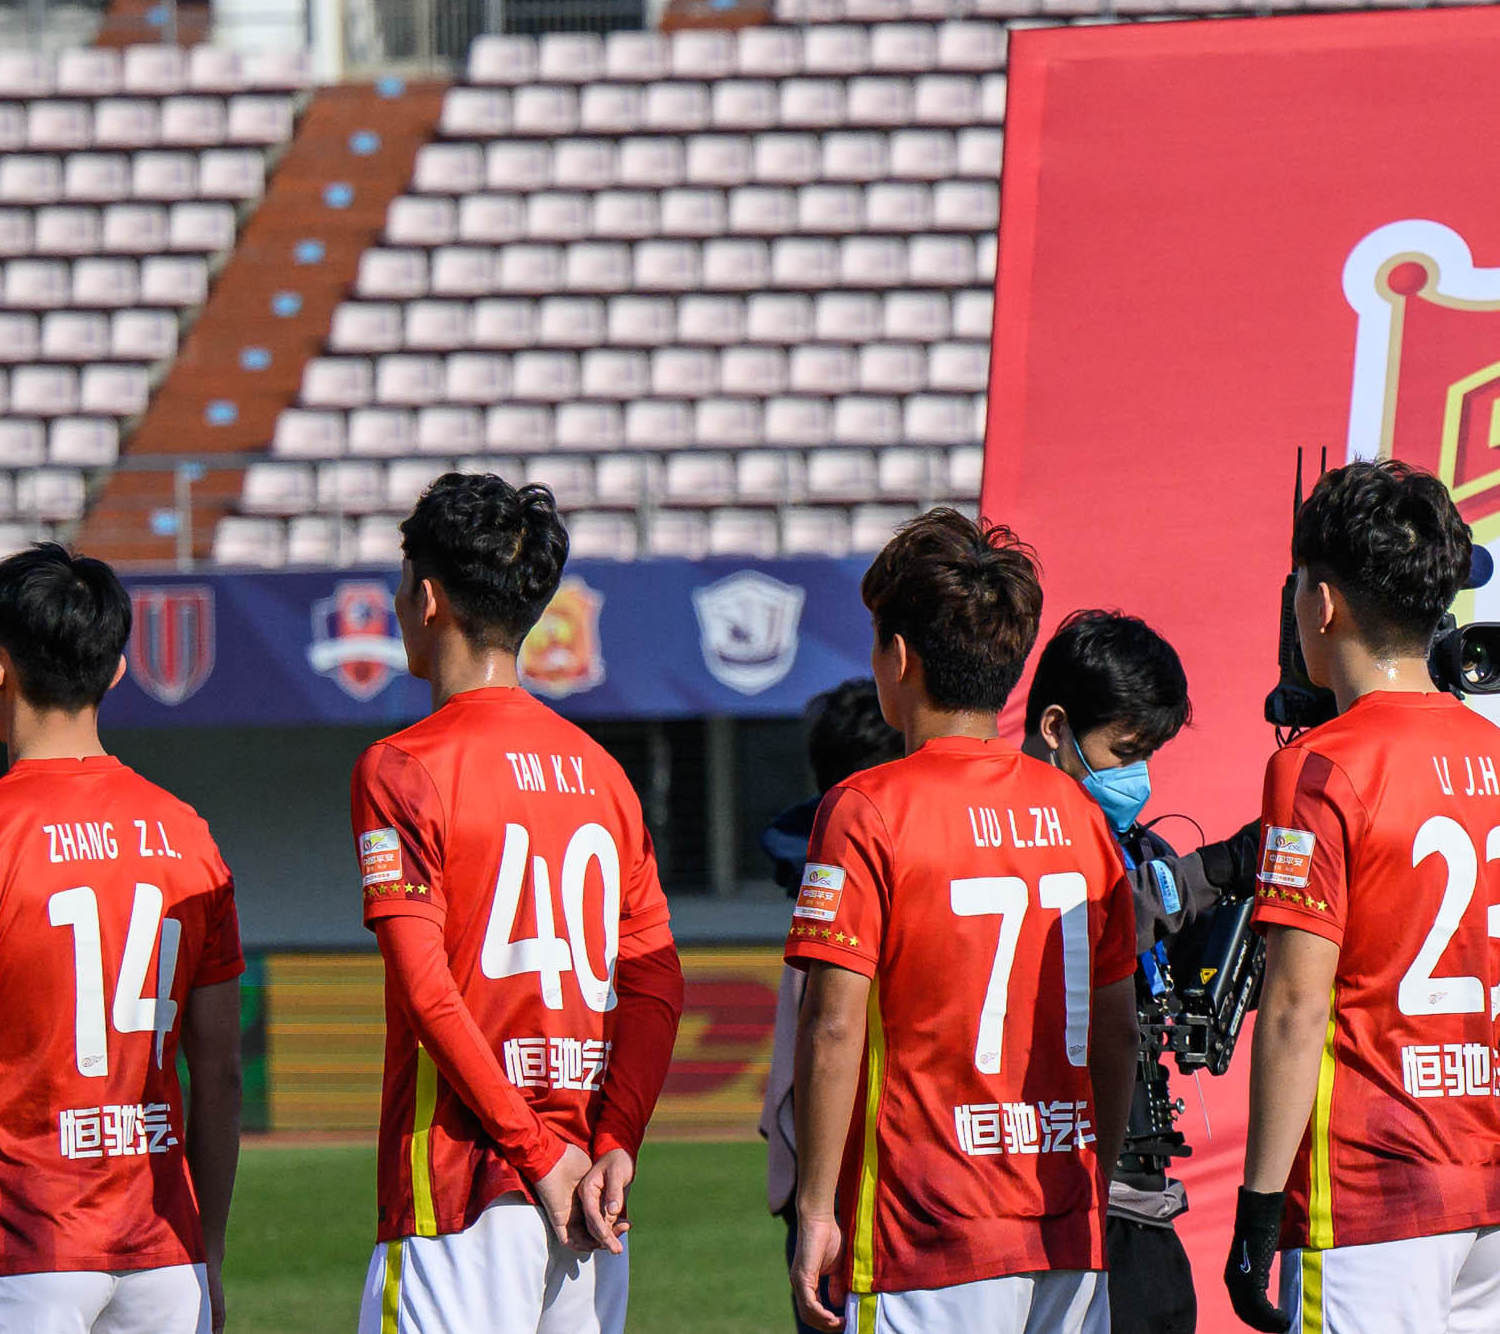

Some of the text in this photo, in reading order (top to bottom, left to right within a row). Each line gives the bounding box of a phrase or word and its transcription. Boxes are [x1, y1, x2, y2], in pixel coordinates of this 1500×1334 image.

[505, 752, 596, 795] TAN K.Y.
[1431, 755, 1454, 796] LI
[42, 820, 182, 864] ZHANG Z.L.
[967, 806, 1073, 849] LIU L.ZH.
[481, 823, 621, 1012] 40
[48, 883, 181, 1078] 14
[950, 872, 1090, 1075] 71
[503, 1037, 612, 1092] 恒驰汽
[60, 1103, 179, 1160] 恒驰汽
